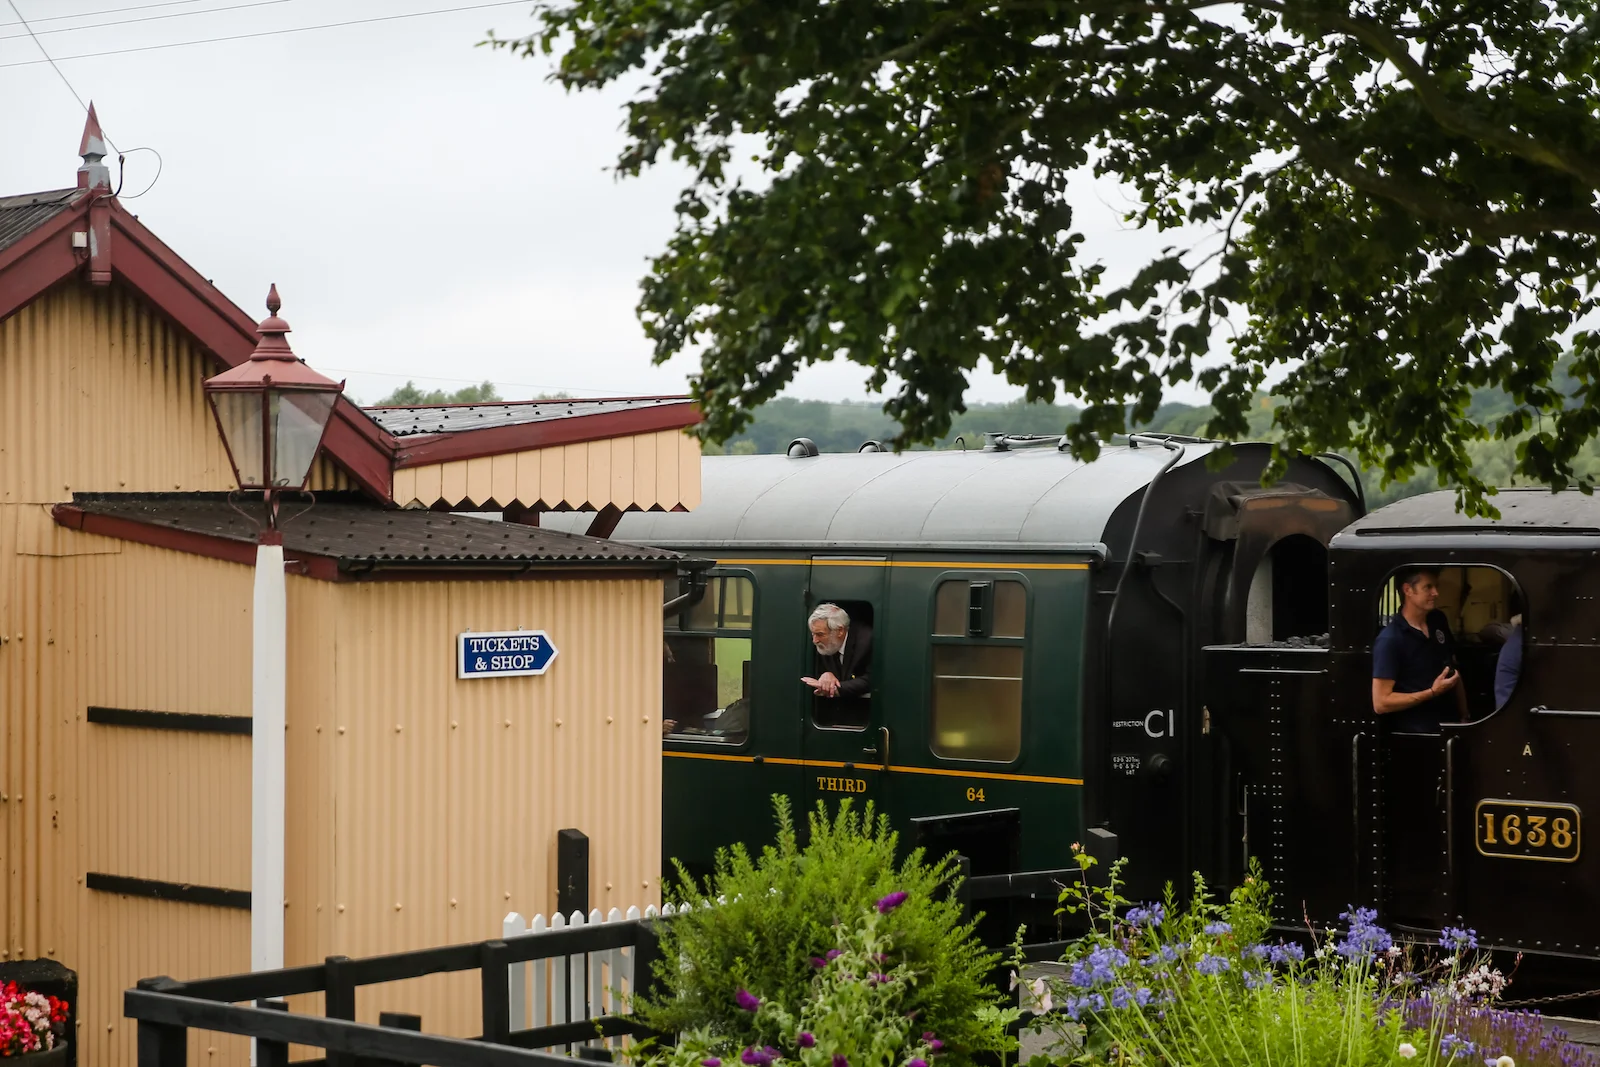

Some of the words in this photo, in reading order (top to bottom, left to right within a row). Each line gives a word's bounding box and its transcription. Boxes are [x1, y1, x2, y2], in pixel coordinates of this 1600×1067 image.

[469, 637, 540, 653] TICKETS
[475, 657, 488, 671] &
[491, 655, 535, 670] SHOP
[1112, 720, 1144, 728] RESTRICTION
[1522, 744, 1533, 756] A
[816, 776, 867, 793] THIRD
[966, 787, 985, 802] 64
[1483, 812, 1573, 849] 1638
